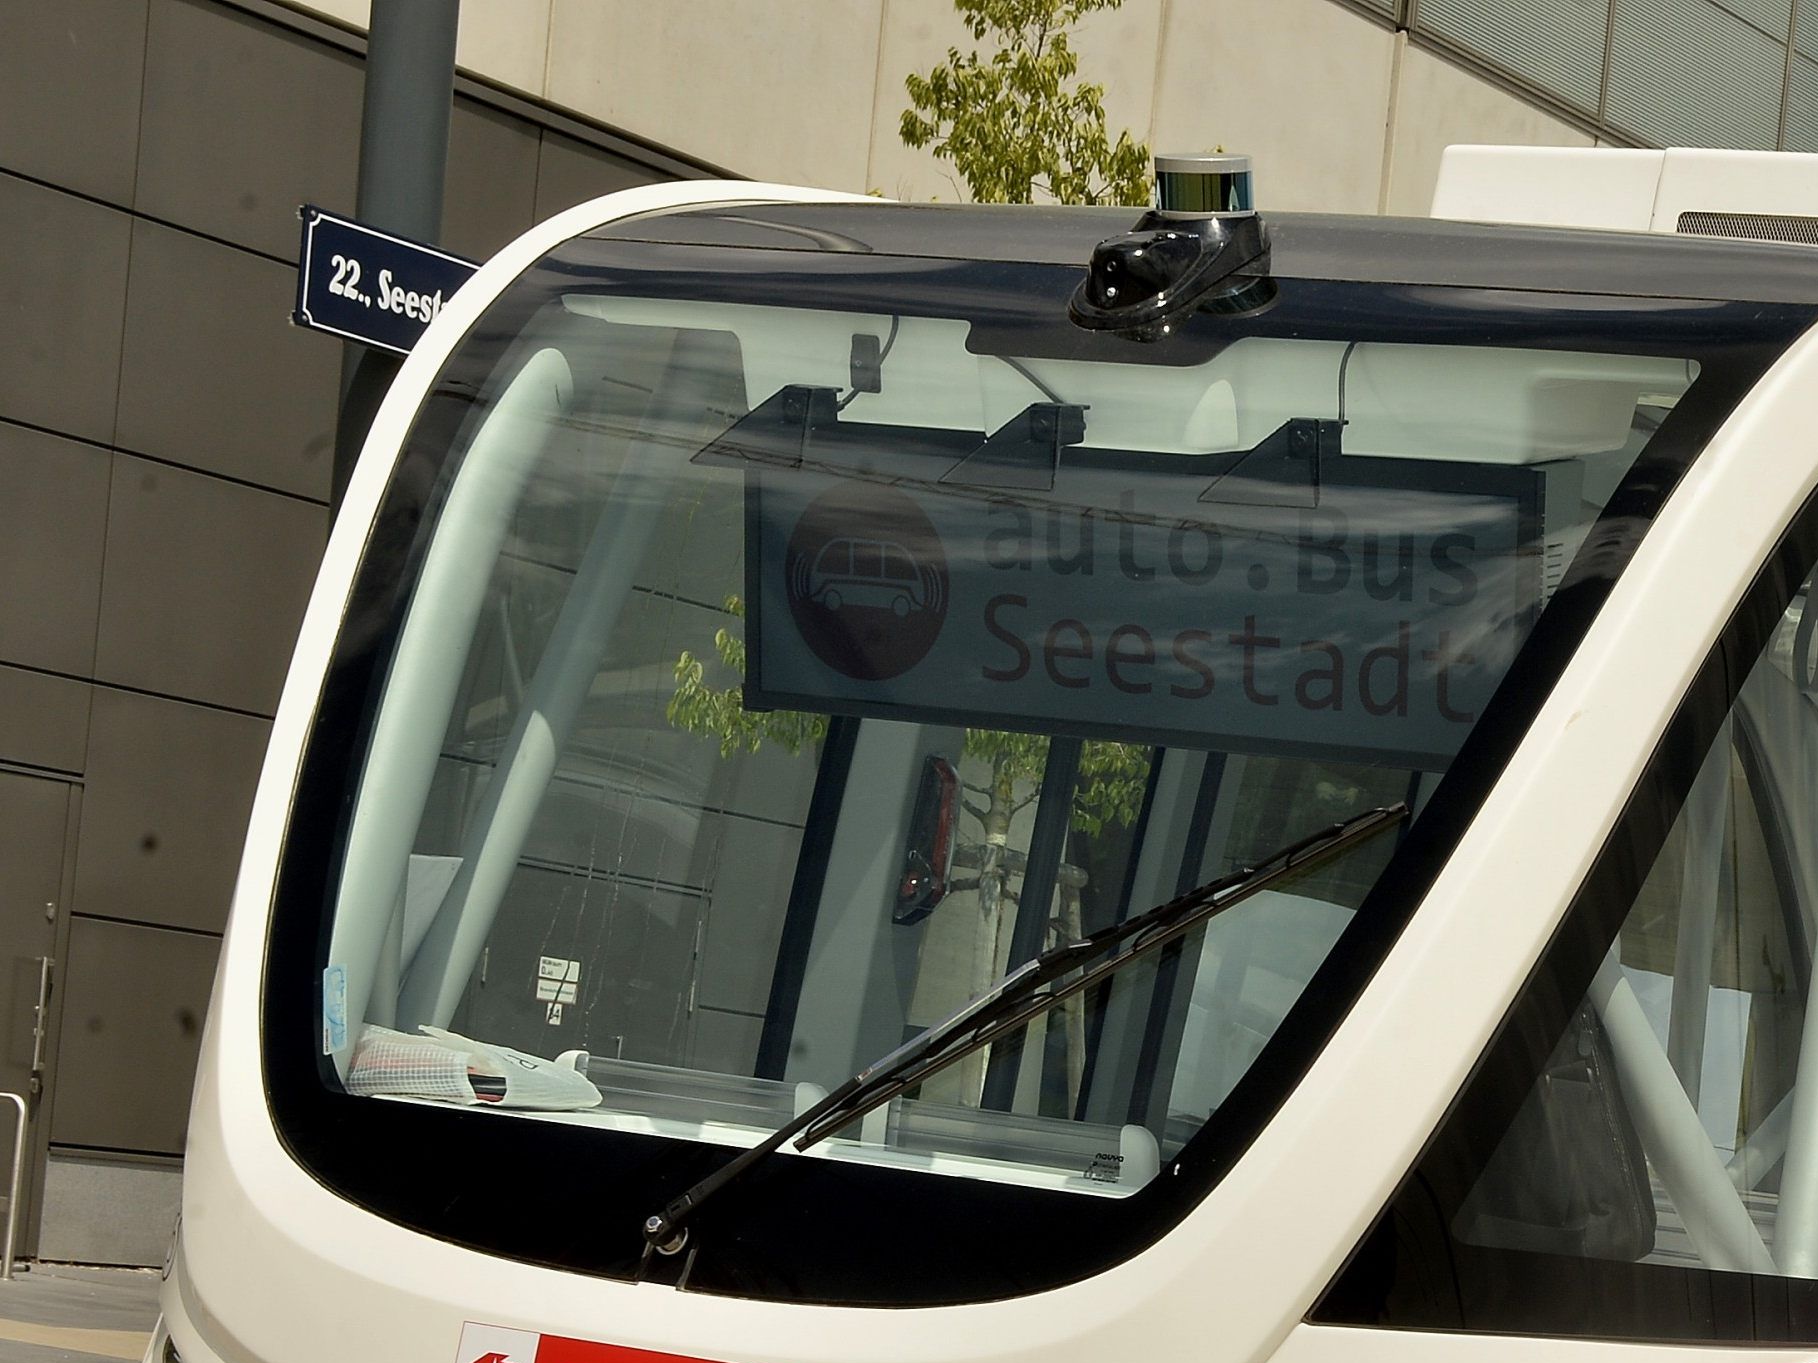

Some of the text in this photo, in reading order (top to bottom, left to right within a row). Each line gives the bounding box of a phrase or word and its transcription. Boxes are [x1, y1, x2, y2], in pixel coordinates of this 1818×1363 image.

[328, 254, 449, 323] 22., Seest
[981, 593, 1476, 724] Seestadt
